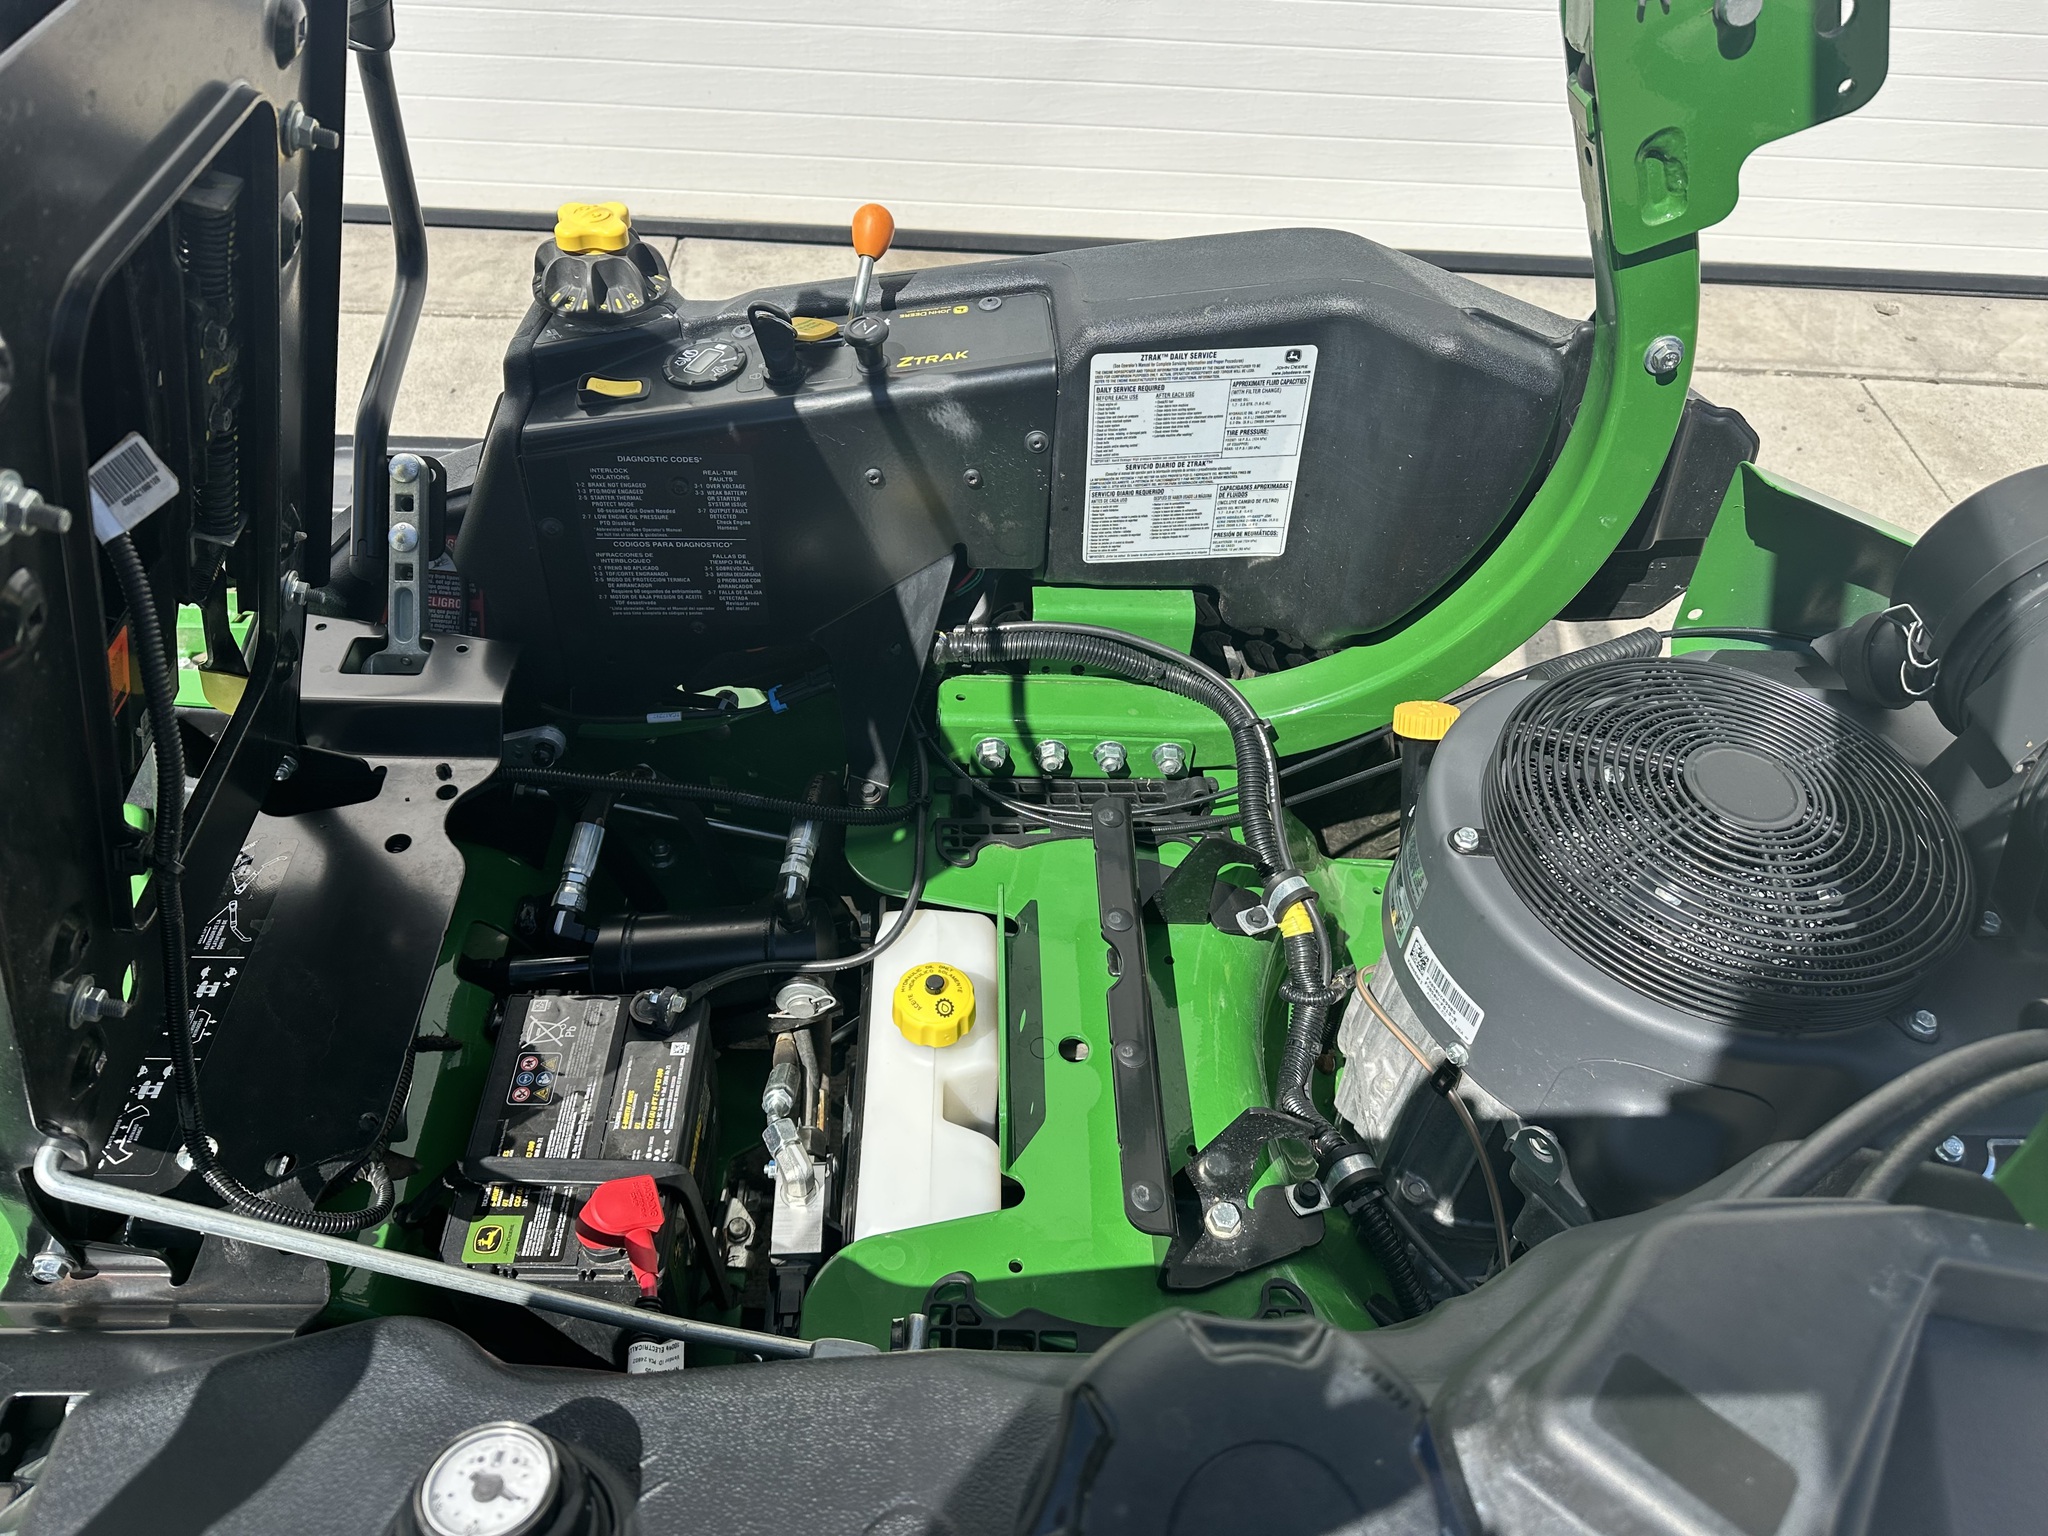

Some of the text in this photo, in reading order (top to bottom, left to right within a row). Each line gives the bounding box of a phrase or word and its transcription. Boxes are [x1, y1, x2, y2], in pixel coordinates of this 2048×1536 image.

[897, 350, 969, 367] ZTRAK
[1170, 352, 1188, 360] DAILY
[1232, 379, 1265, 387] APPROXIMATE
[1136, 488, 1165, 496] REQUERIDO
[1244, 529, 1278, 537] NEUMÁTICOS:
[428, 596, 461, 608] ELIGRO
[901, 968, 922, 992] HYDRAULIC
[908, 969, 963, 1010] ACEITE HIDRAULICO SOLAMENTE
[565, 1025, 577, 1038] Pb
